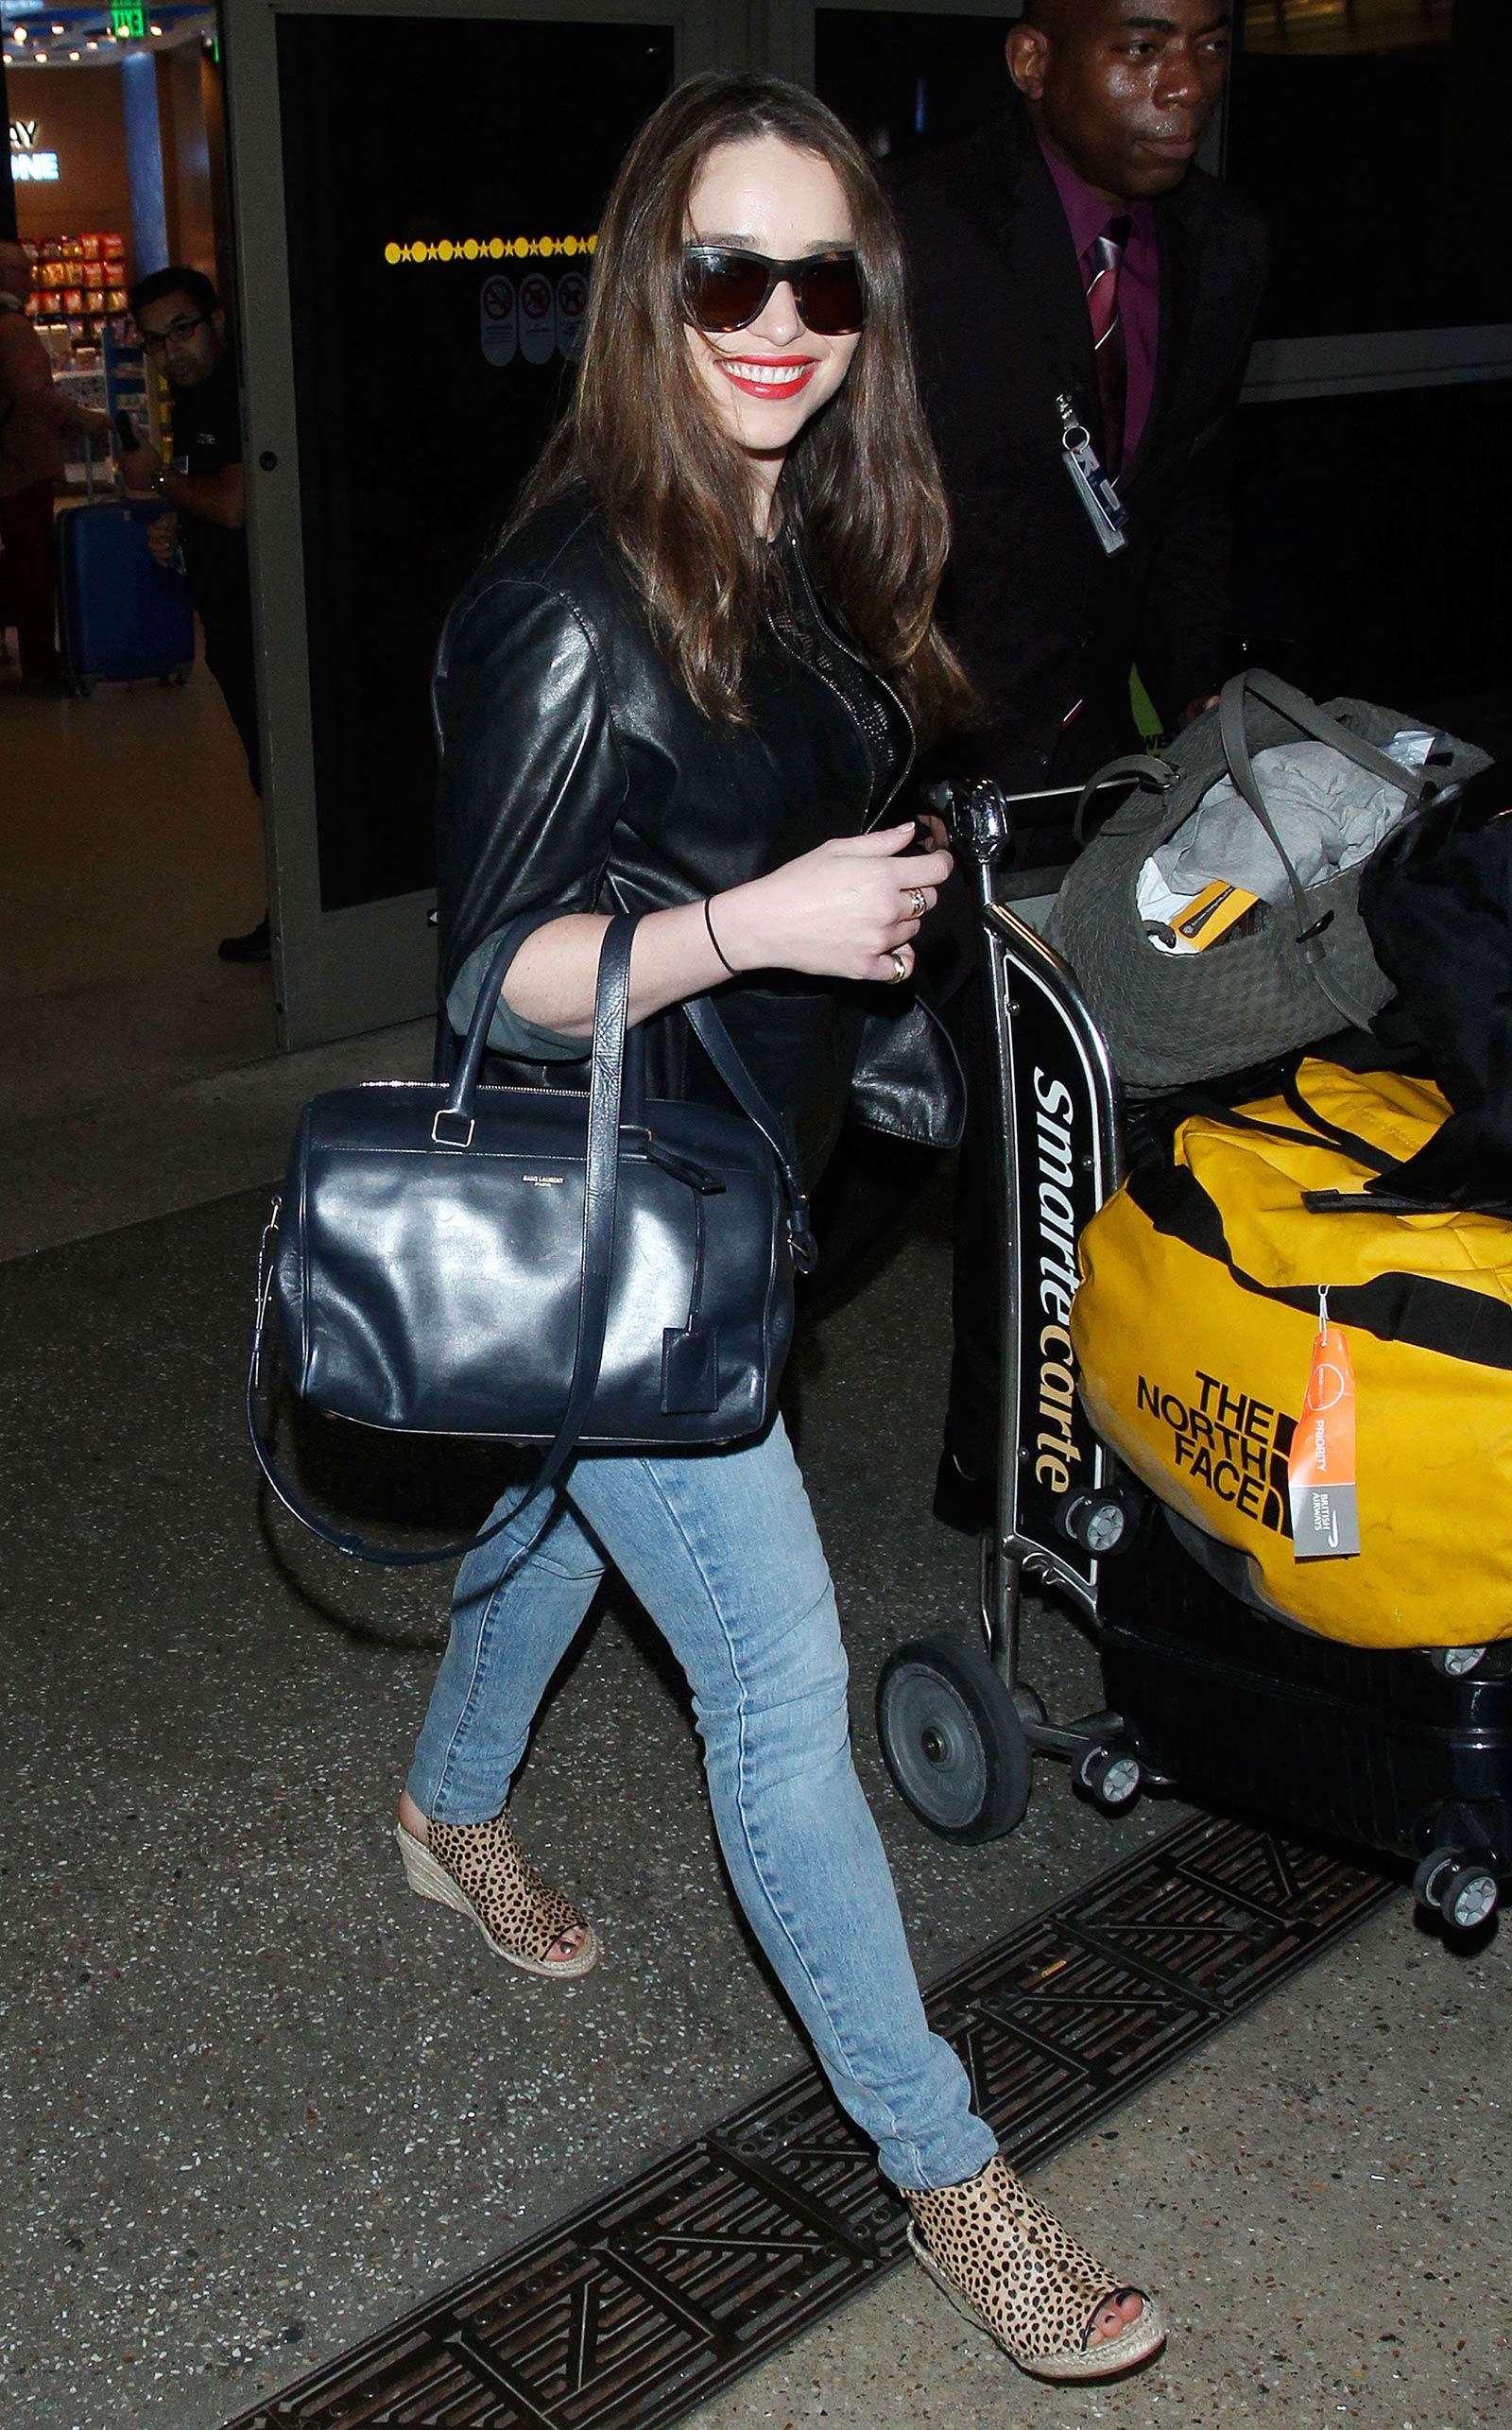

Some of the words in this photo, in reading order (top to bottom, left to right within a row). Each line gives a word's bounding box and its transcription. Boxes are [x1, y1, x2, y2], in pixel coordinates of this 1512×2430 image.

[1137, 1374, 1267, 1482] NORTH
[1195, 1370, 1274, 1444] THE
[1175, 1431, 1265, 1521] FACE
[1315, 1419, 1327, 1472] PRIORITY
[1312, 1491, 1323, 1531] AIRWAYS
[1320, 1493, 1331, 1530] BRITISH
